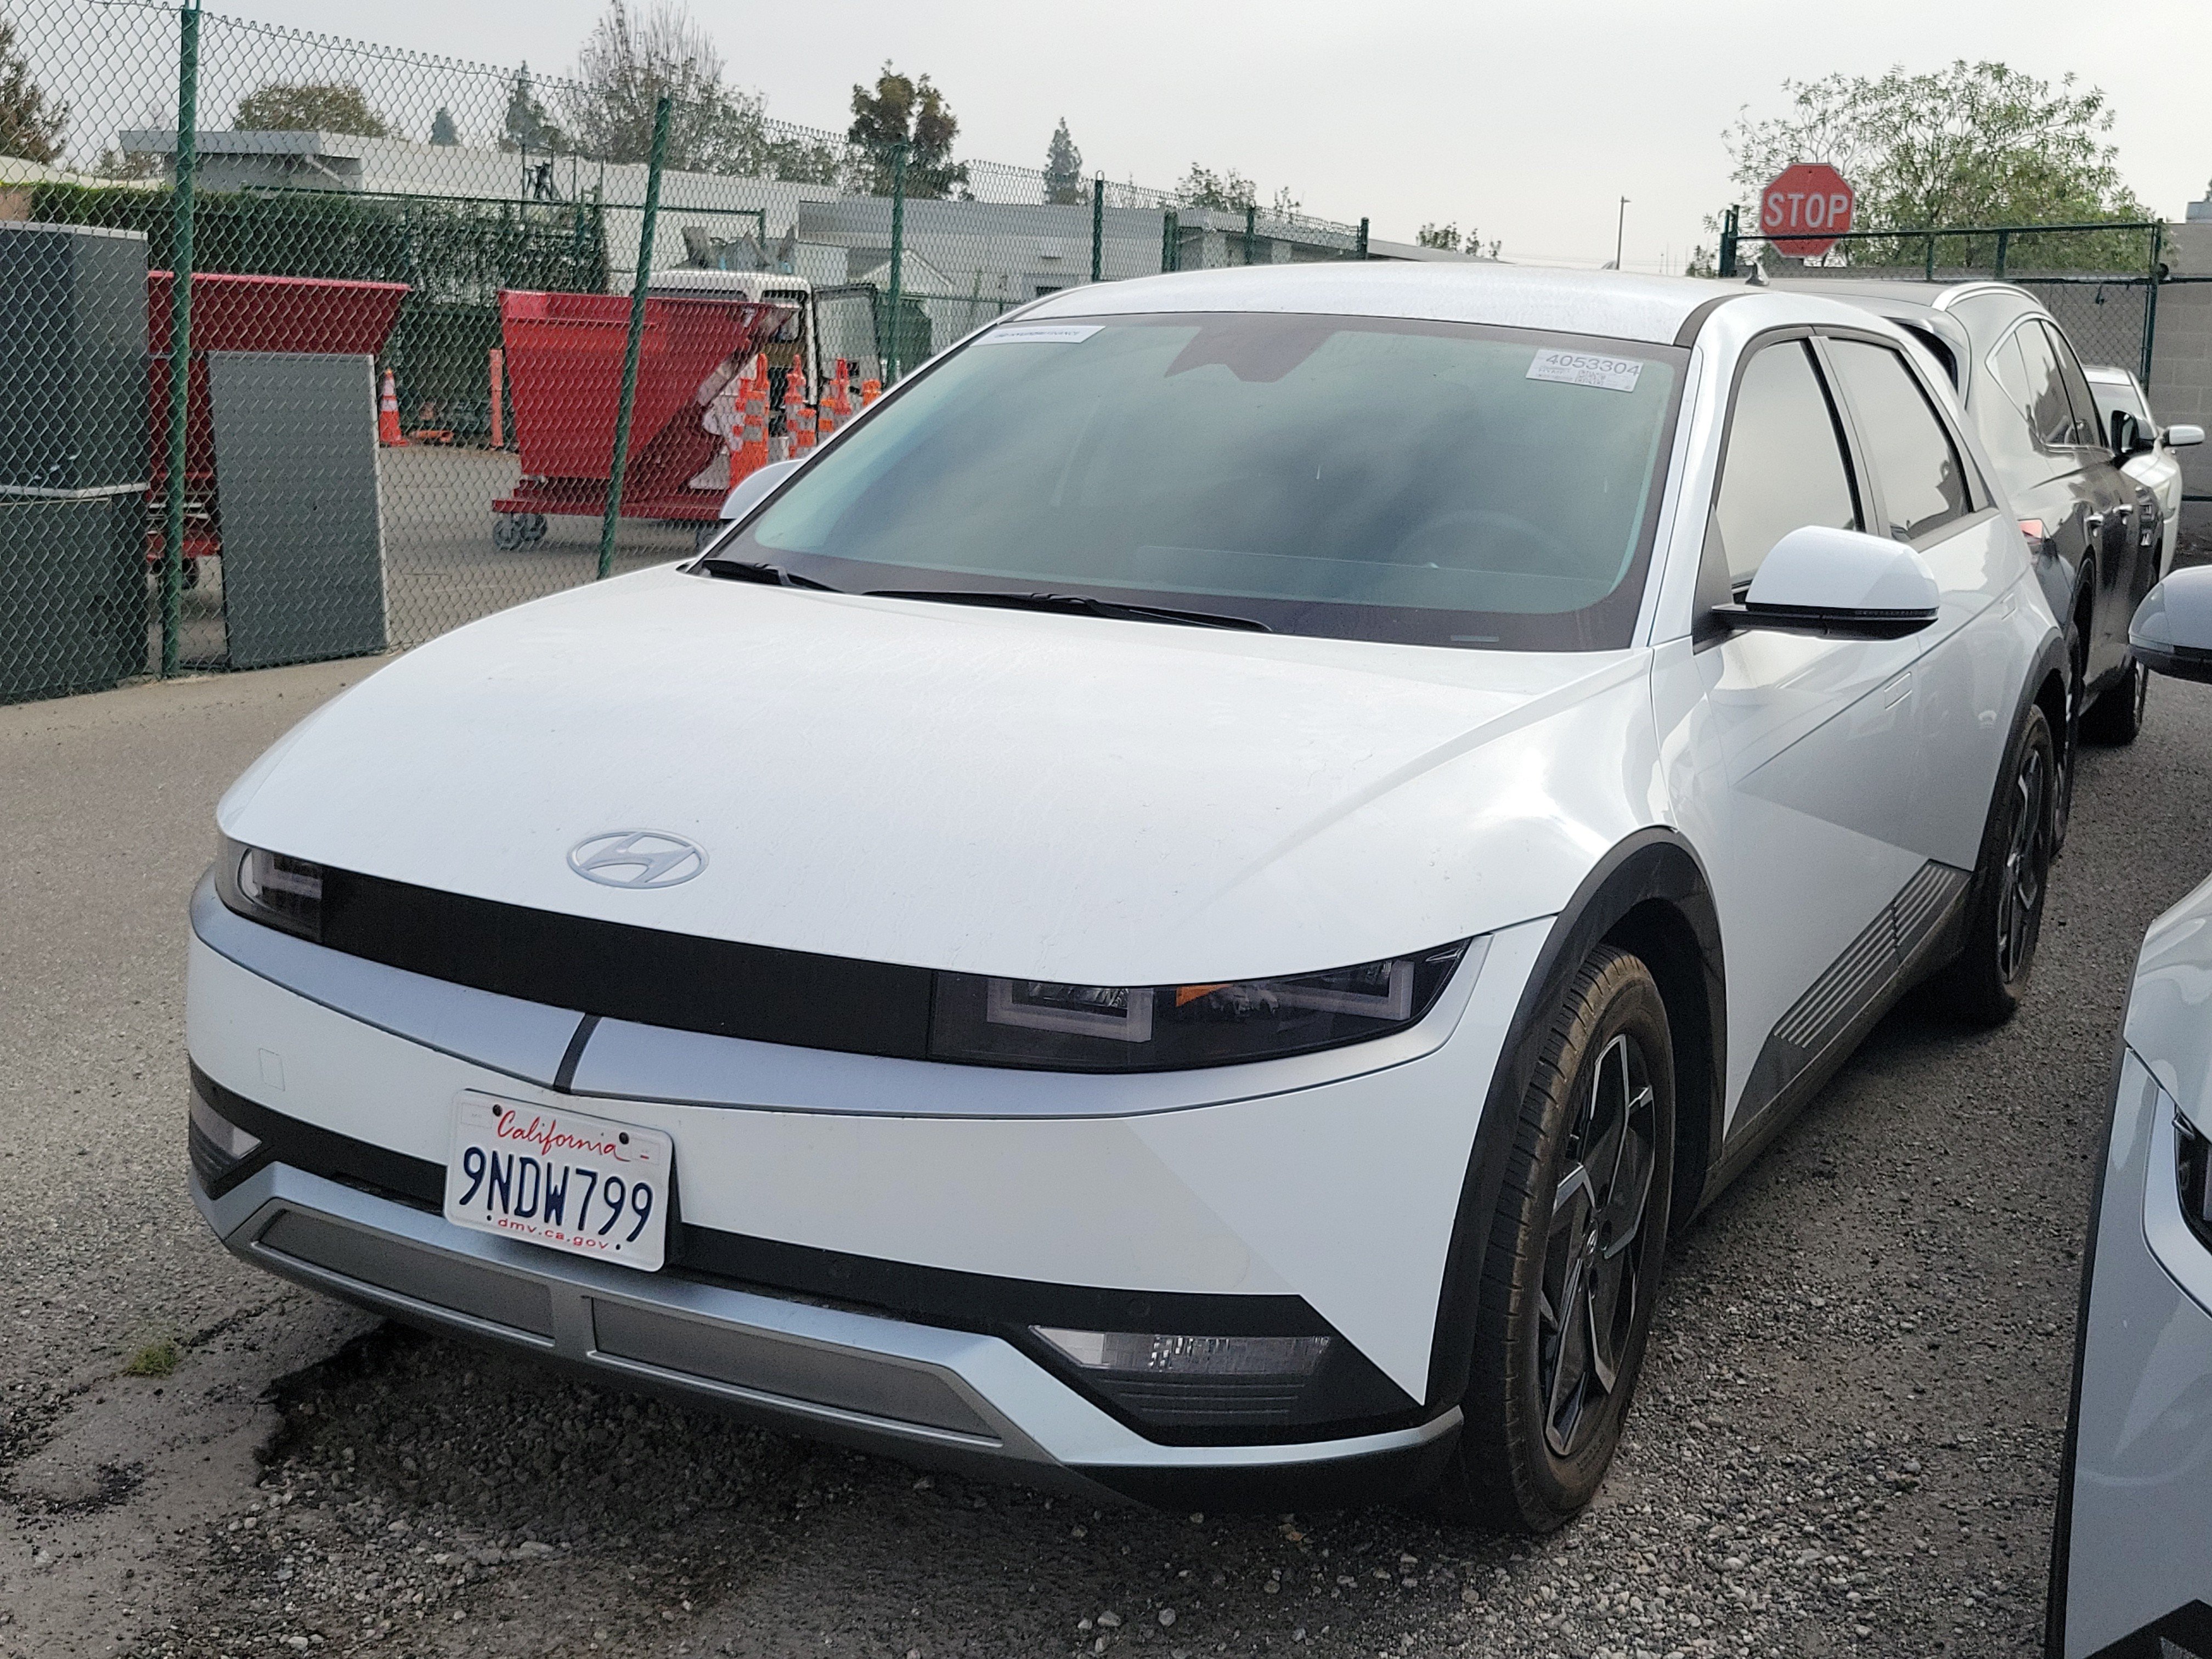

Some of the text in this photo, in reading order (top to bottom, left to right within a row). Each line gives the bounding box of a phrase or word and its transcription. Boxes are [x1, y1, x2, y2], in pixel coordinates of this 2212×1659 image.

[1764, 194, 1848, 228] STOP
[1546, 354, 1639, 376] 4053304
[497, 1110, 631, 1162] California
[459, 1147, 653, 1242] 9NDW799
[498, 1218, 608, 1249] dmv.ca.gov
